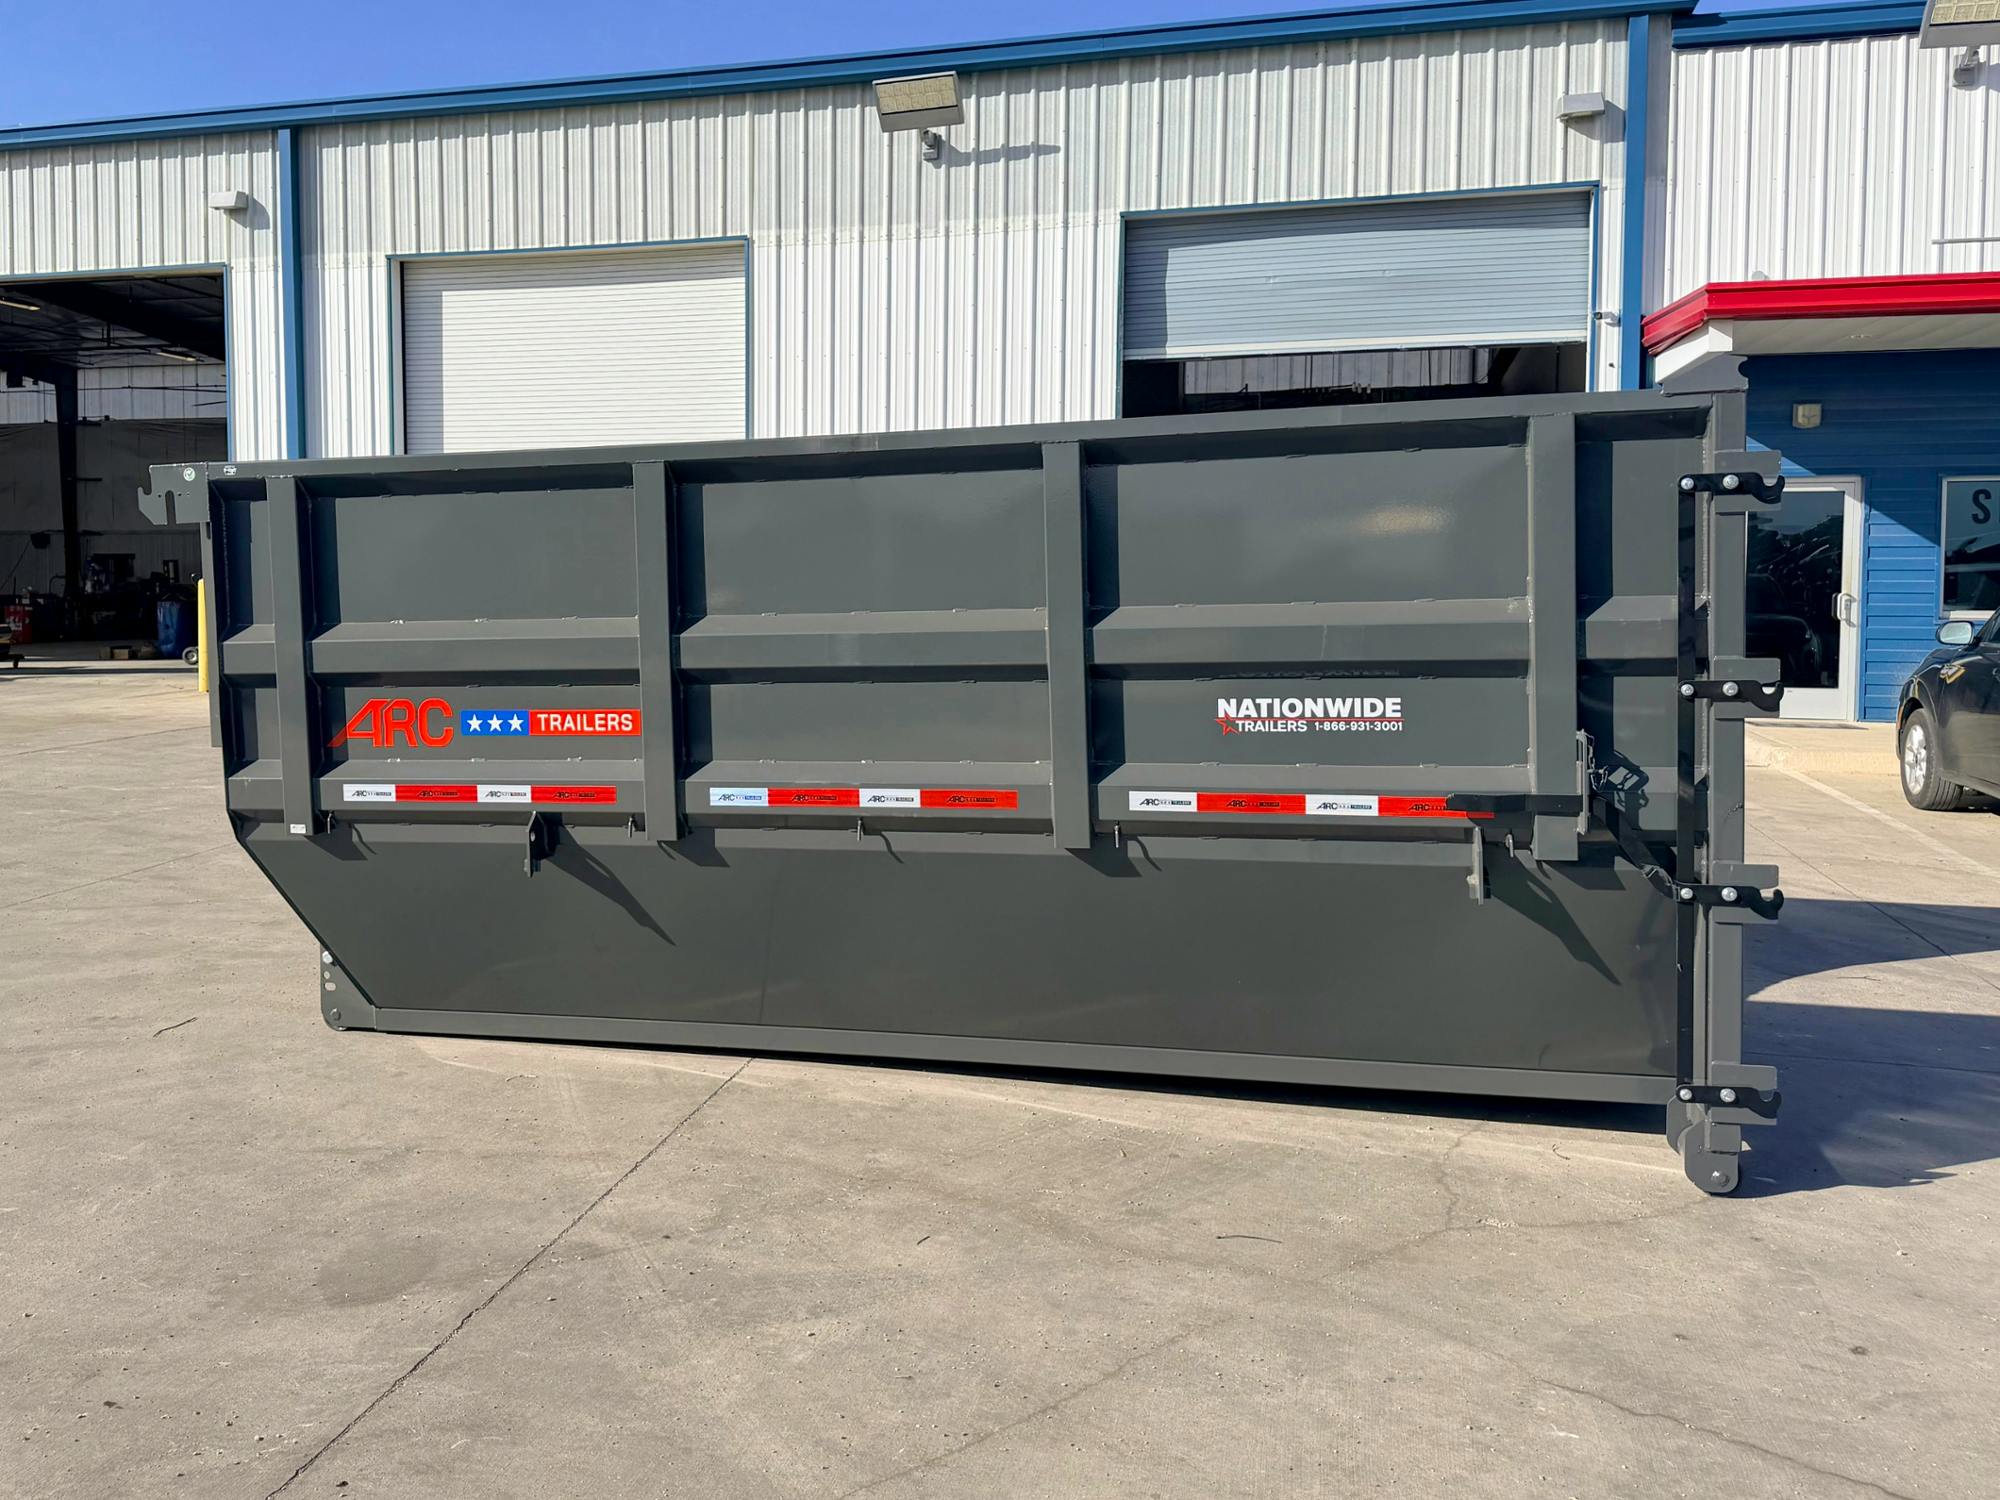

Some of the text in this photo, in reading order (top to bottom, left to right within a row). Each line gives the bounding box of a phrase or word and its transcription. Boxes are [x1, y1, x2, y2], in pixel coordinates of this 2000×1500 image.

[1971, 488, 2000, 525] S
[1217, 697, 1402, 718] NATIONWIDE
[327, 698, 633, 748] ARC TRAILERS
[1235, 720, 1403, 732] TRAILERS 1-866-931-3001
[867, 795, 885, 803] ARC
[1139, 798, 1160, 806] ARC
[1226, 799, 1247, 808] ARC
[1316, 802, 1338, 810] ARC
[1408, 803, 1430, 812] ARC
